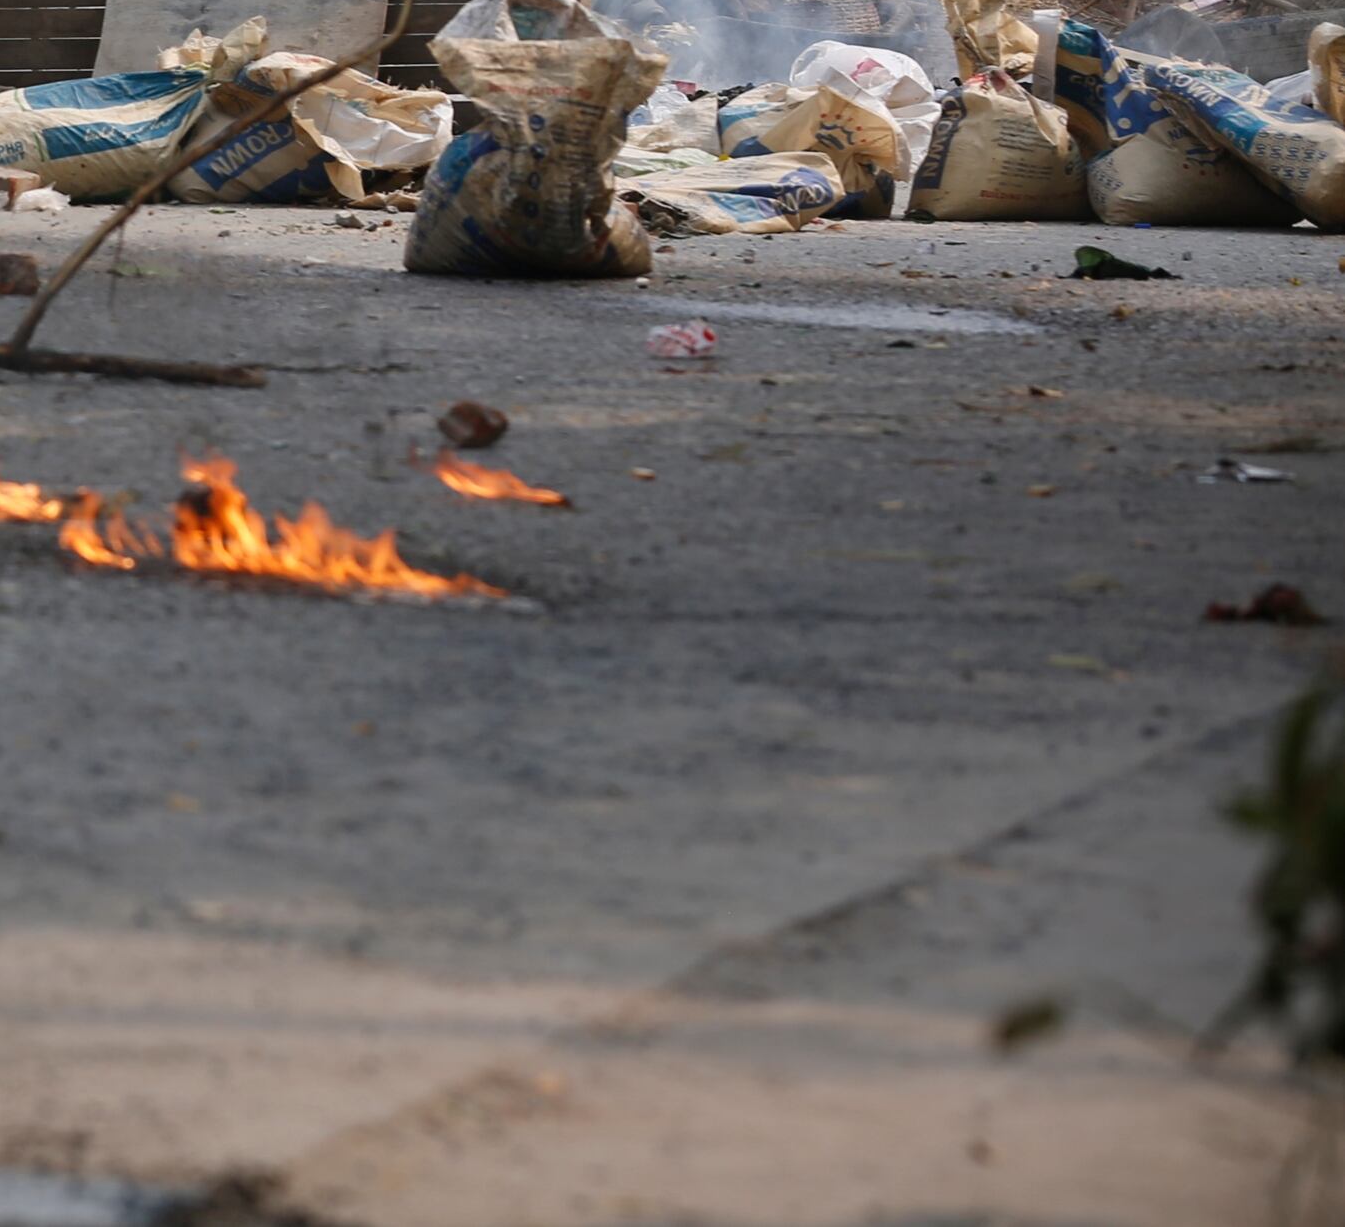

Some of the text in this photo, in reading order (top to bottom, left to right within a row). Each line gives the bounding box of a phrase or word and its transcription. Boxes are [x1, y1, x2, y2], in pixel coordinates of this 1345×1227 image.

[1154, 64, 1223, 108] CROWN
[212, 121, 293, 179] CROWN
[918, 95, 965, 178] CROWN
